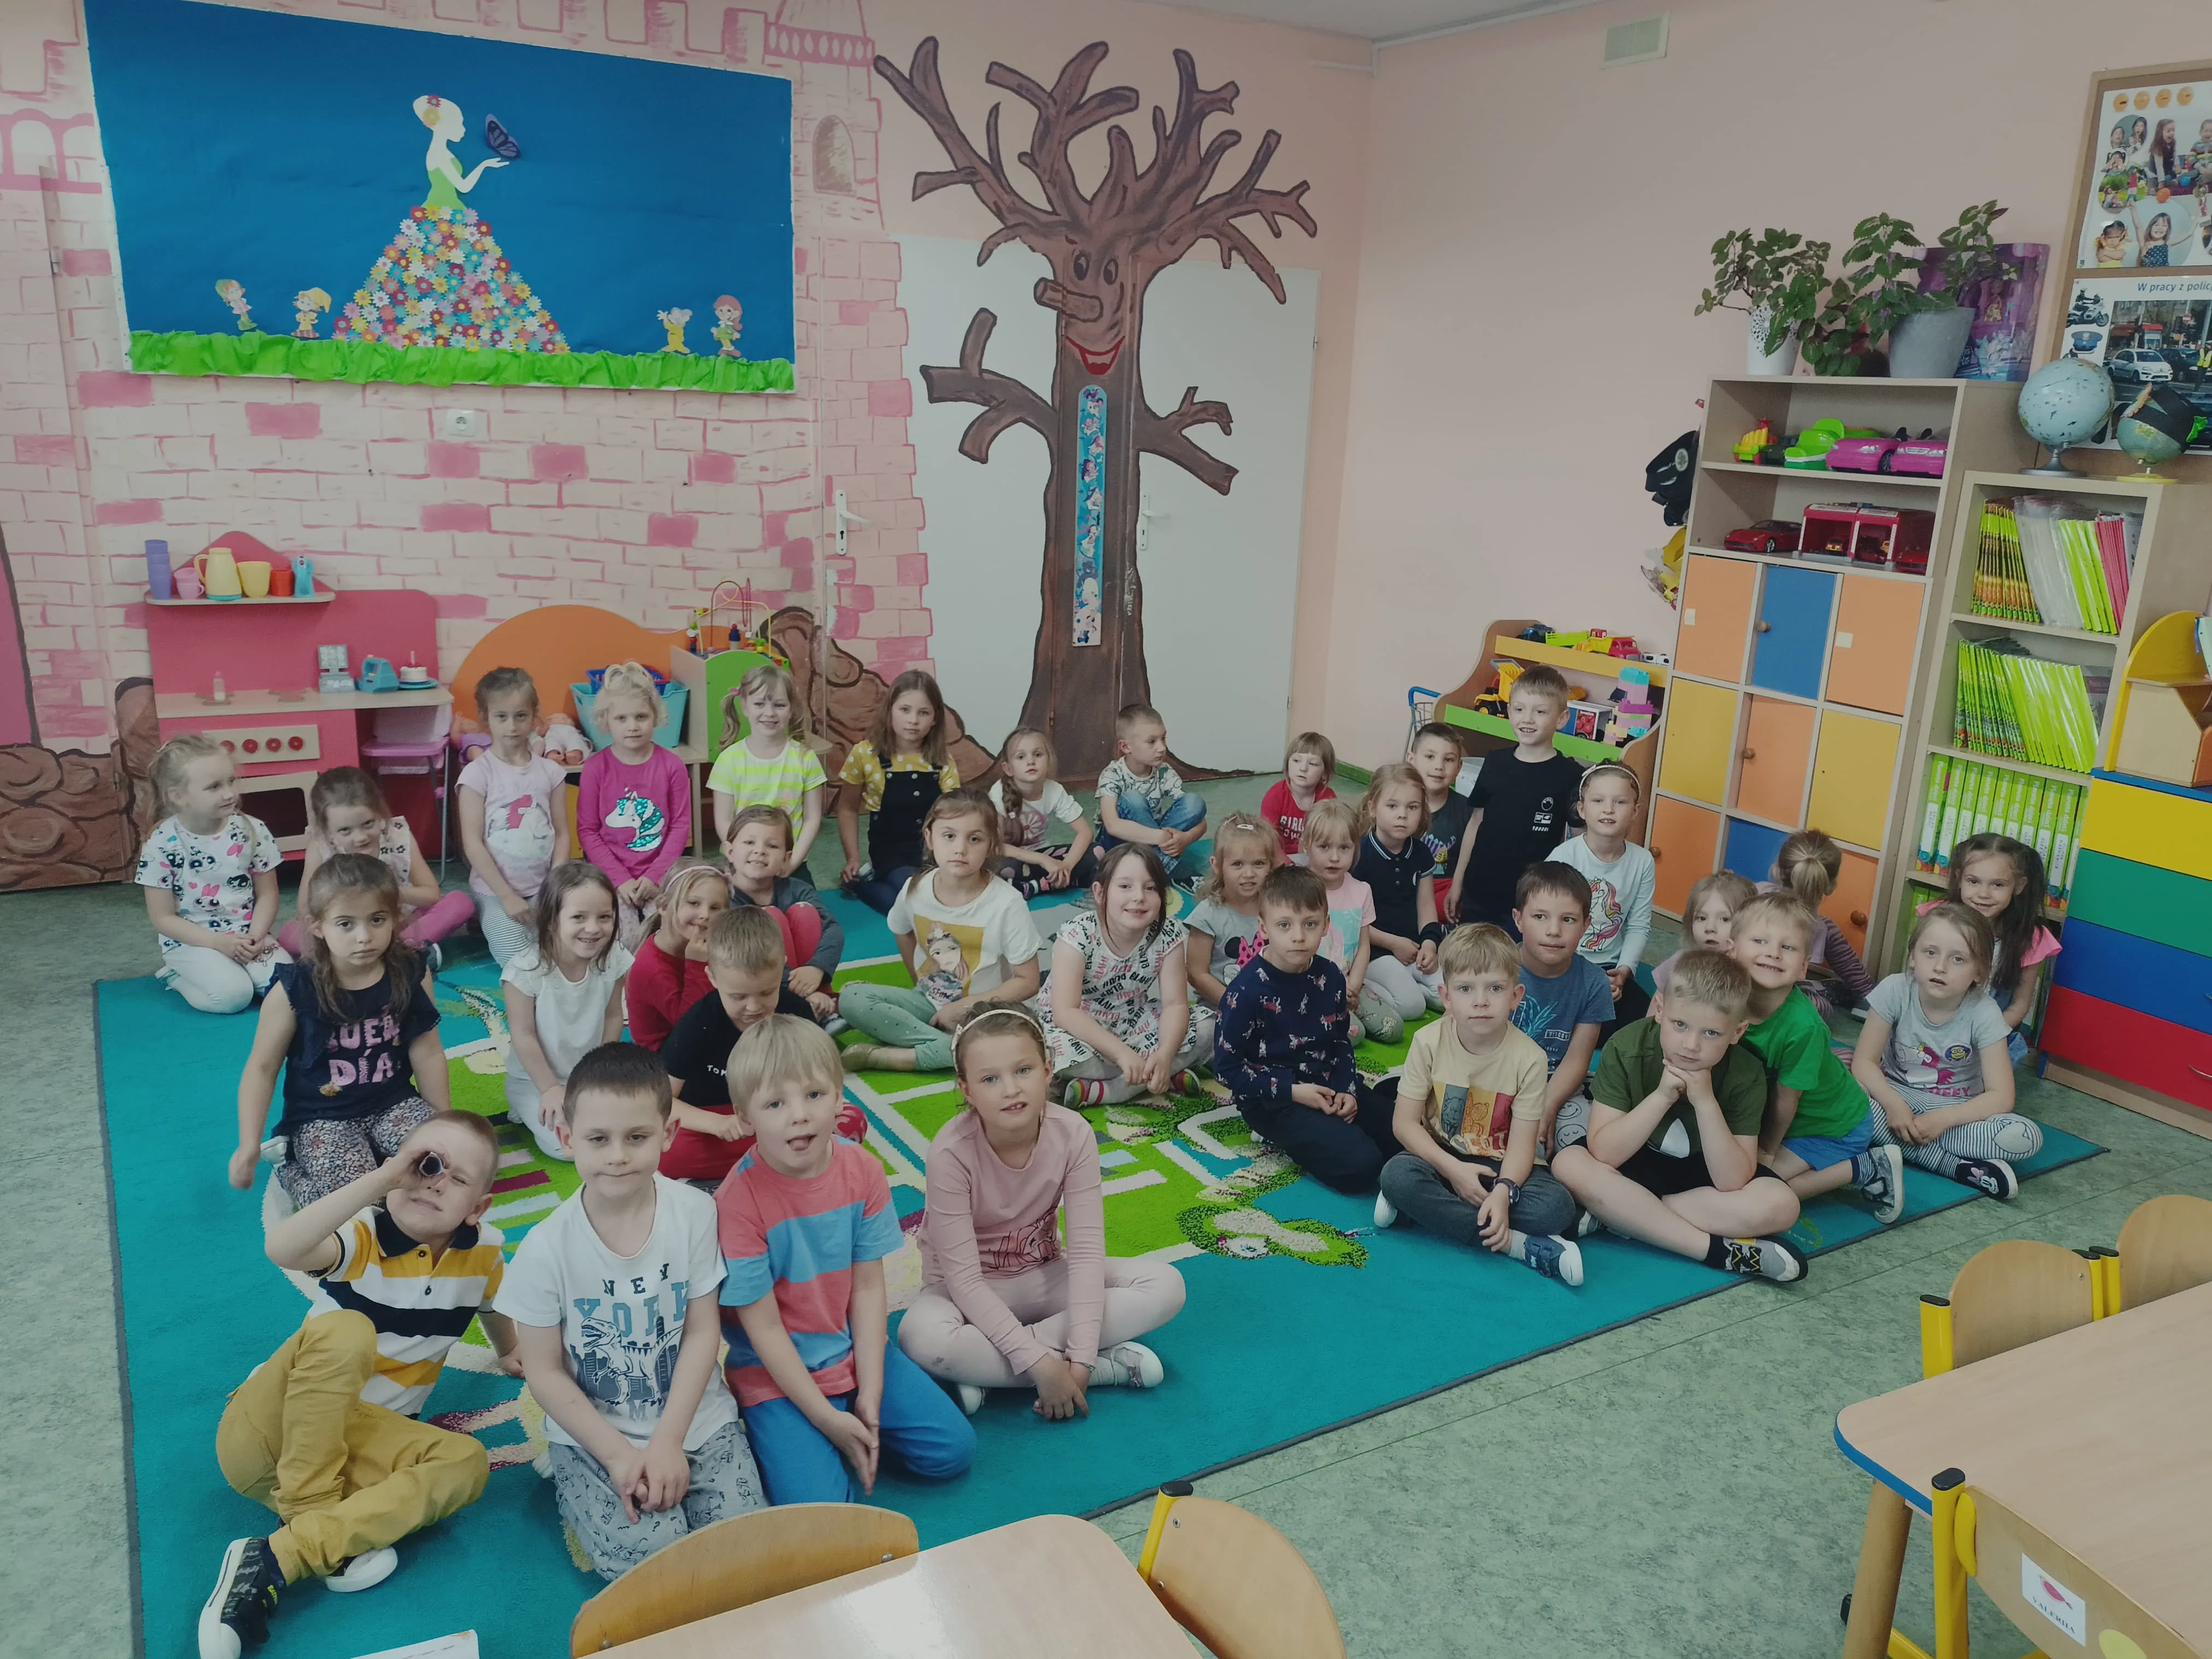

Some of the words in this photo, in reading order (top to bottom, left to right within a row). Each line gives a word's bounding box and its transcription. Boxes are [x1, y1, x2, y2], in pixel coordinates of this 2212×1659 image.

[2138, 283, 2147, 291] W
[2149, 284, 2176, 293] pracy
[2179, 283, 2184, 291] z
[2000, 775, 2010, 797] Planeta
[2015, 778, 2024, 801] Planeta
[2029, 781, 2039, 804] Planeta
[2047, 785, 2057, 808] Planeta
[2064, 789, 2074, 812] Planeta
[1997, 799, 2006, 816] dzieci
[2012, 803, 2021, 819] dzieci
[2027, 806, 2035, 823] dzieci
[2044, 810, 2053, 828] dzieci
[2061, 814, 2070, 832] dzieci
[329, 1048, 394, 1087] DÍA
